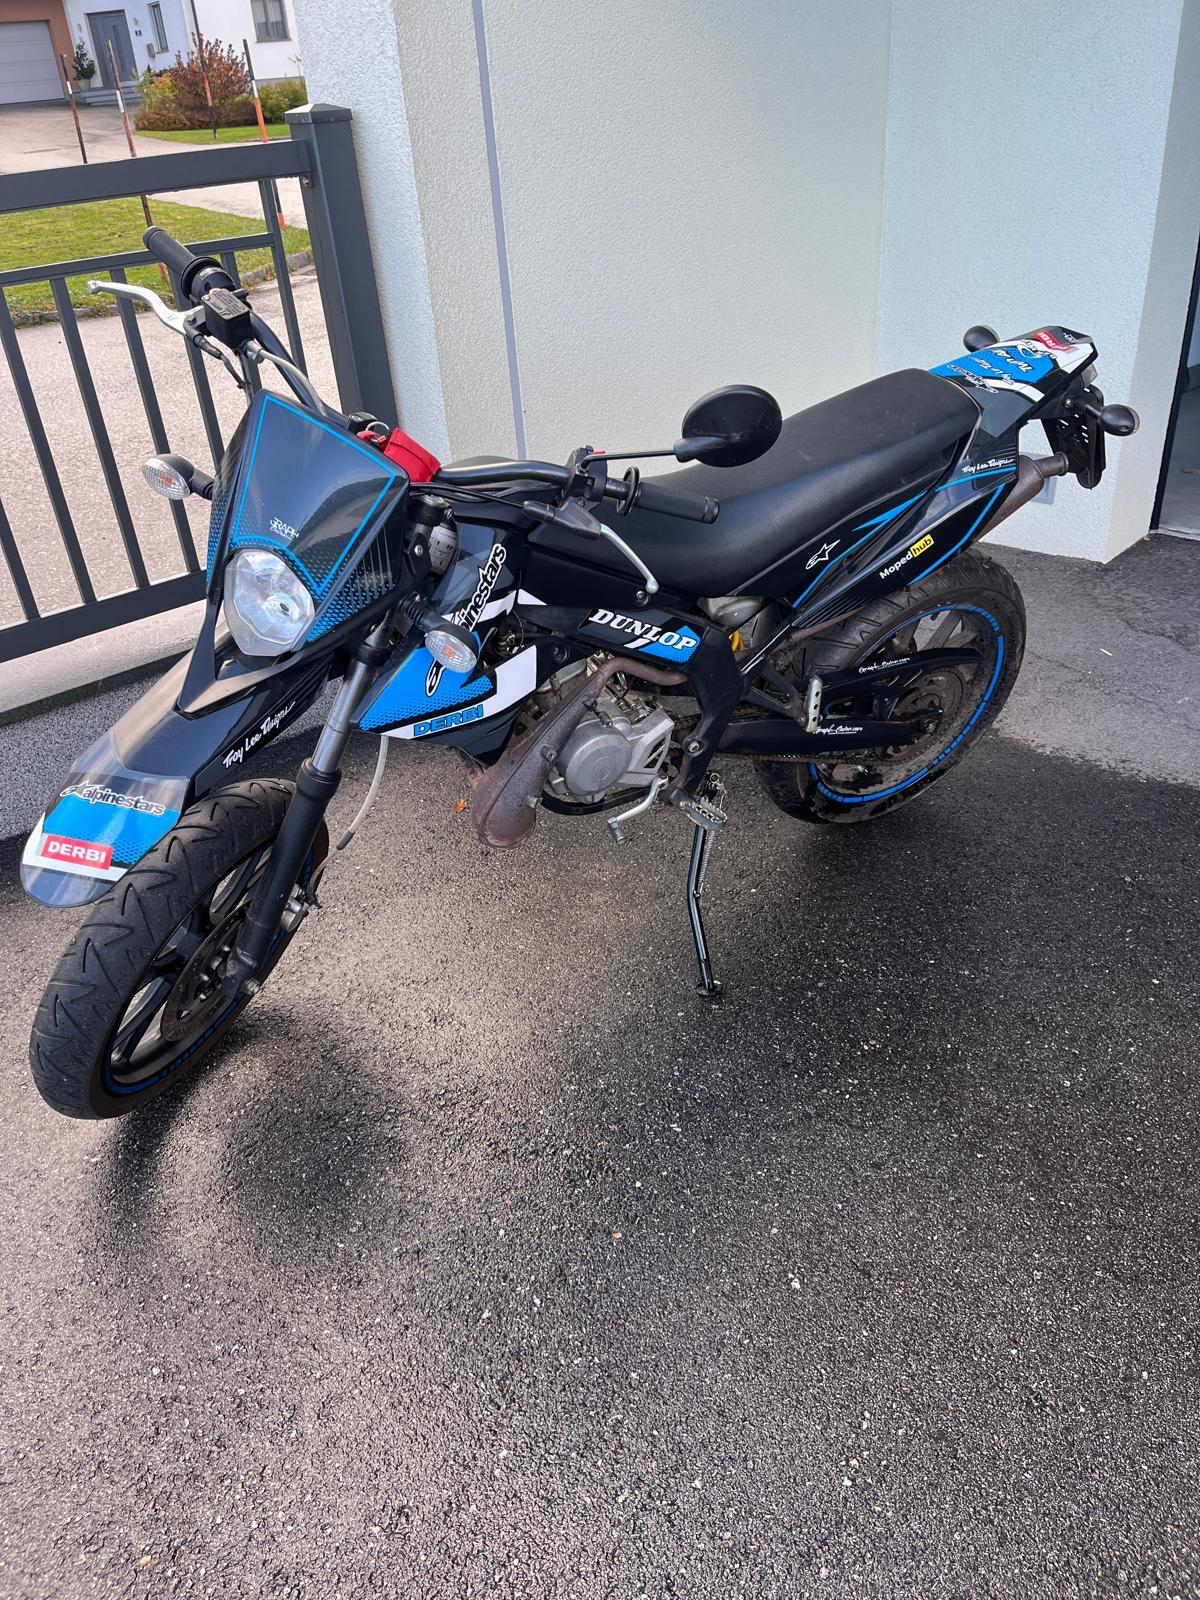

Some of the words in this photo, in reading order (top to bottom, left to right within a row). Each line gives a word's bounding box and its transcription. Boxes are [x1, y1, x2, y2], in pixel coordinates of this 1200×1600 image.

[588, 608, 697, 650] DUNLOP
[413, 703, 484, 737] DERBI
[222, 747, 244, 769] Troy
[245, 737, 262, 752] Lee
[82, 786, 167, 816] alpinestars
[47, 841, 107, 864] DERBI
